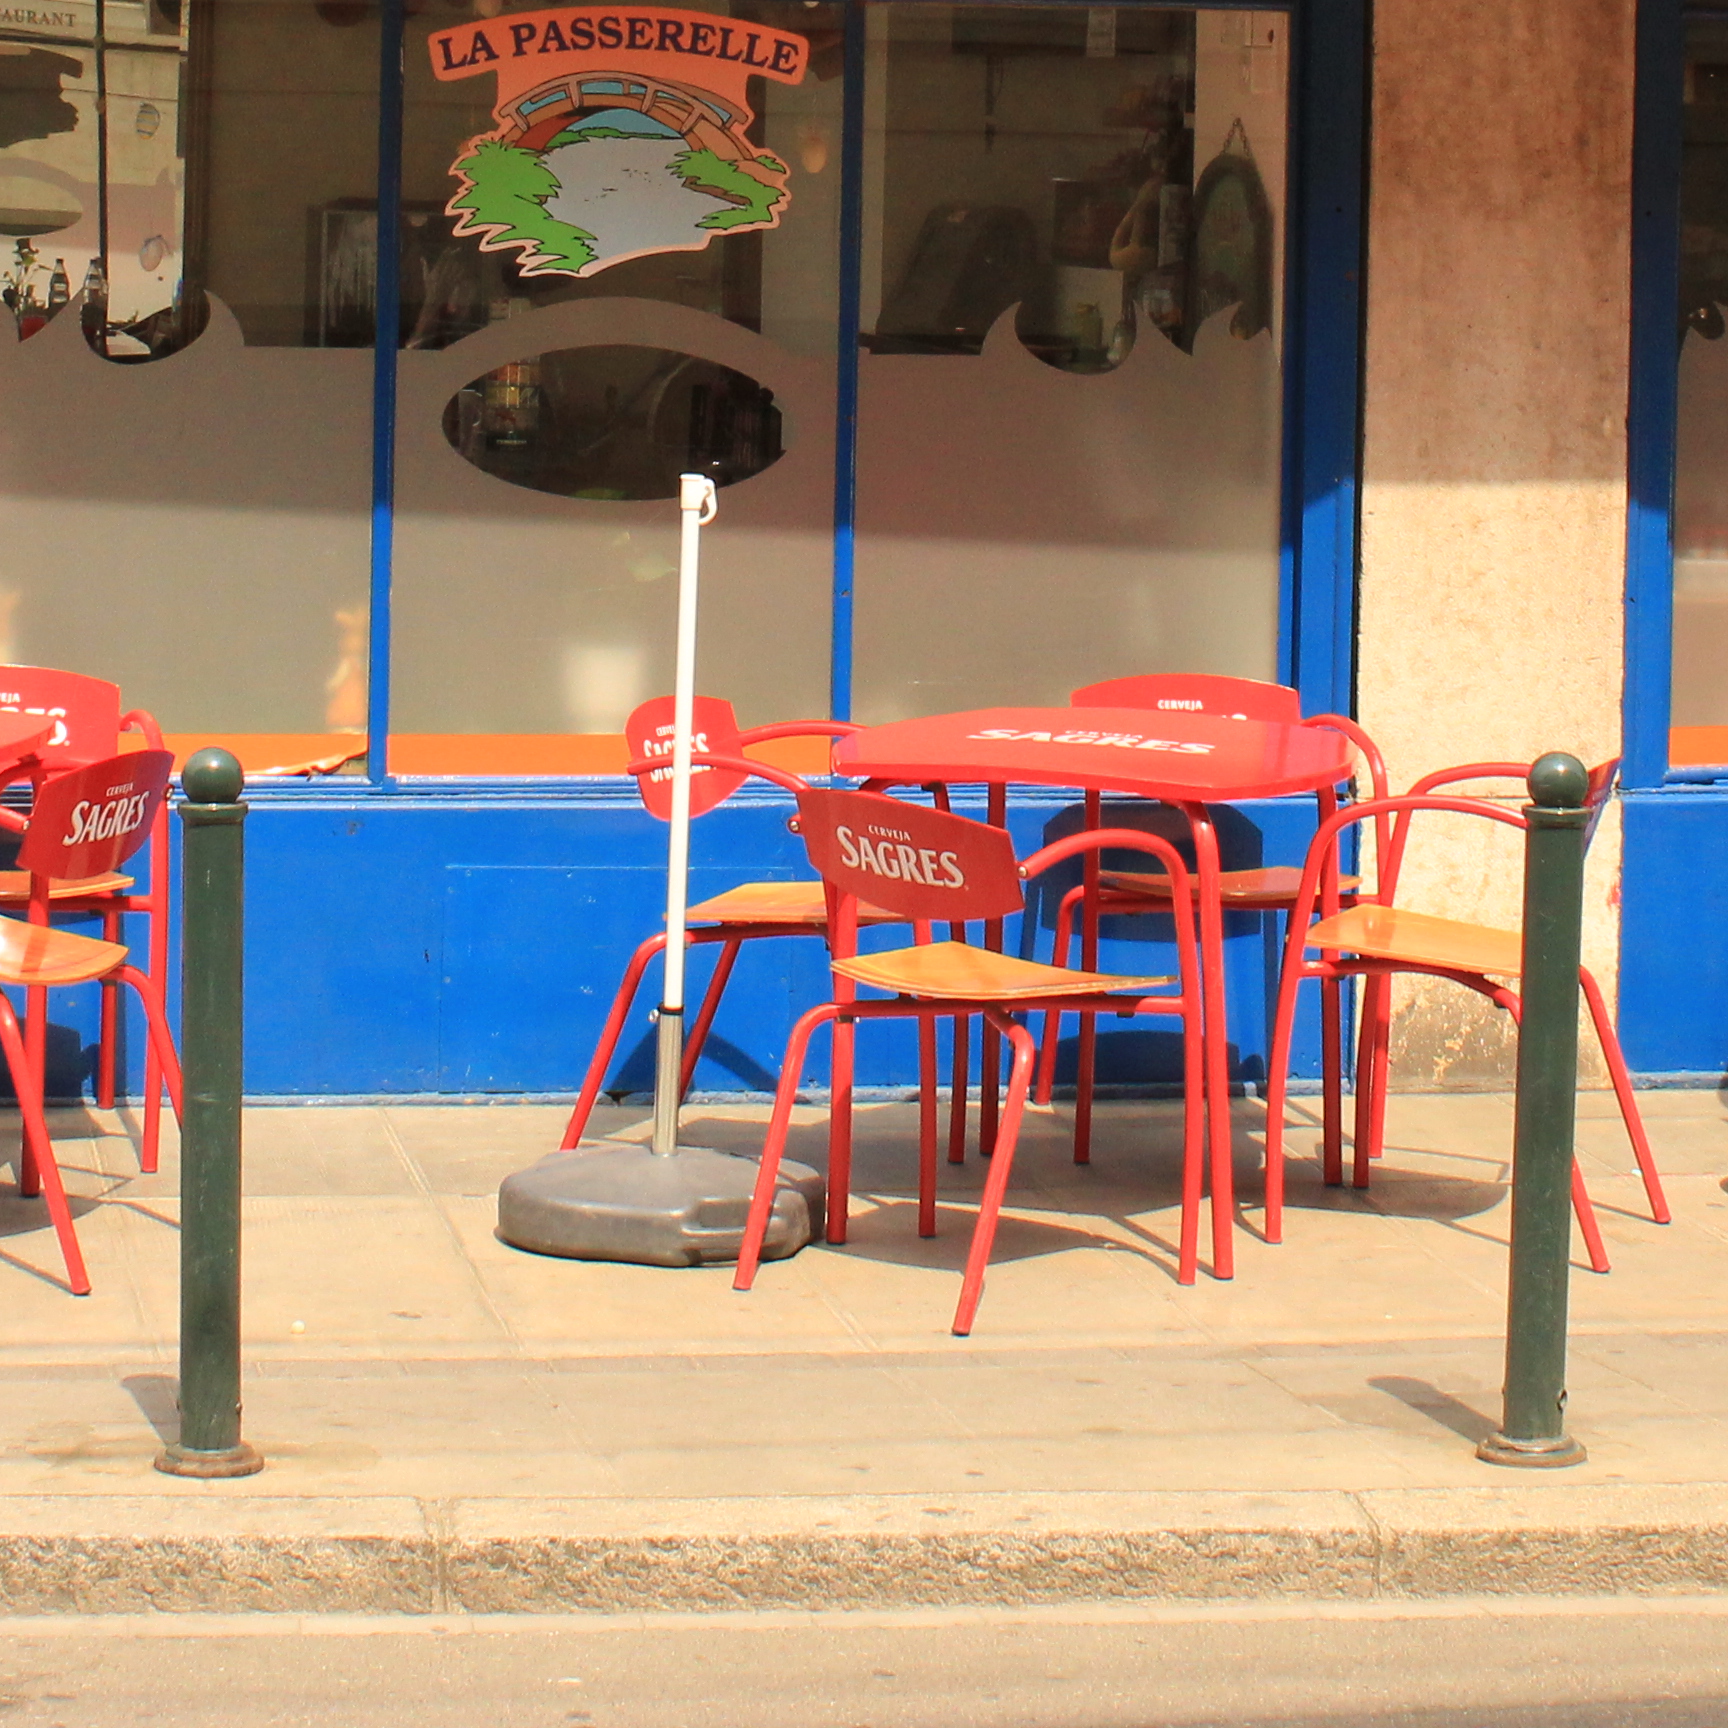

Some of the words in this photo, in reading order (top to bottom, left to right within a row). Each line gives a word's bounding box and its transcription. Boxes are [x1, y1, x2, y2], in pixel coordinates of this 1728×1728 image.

[438, 29, 500, 72] LA
[509, 16, 799, 75] PASSERELLE
[1157, 699, 1203, 711] CERVEJA
[966, 729, 1216, 755] SAGRES
[106, 783, 134, 798] CERVEJA
[62, 791, 150, 847] SAGRES
[868, 824, 911, 842] CERVEJA
[836, 825, 965, 889] SAGRES
